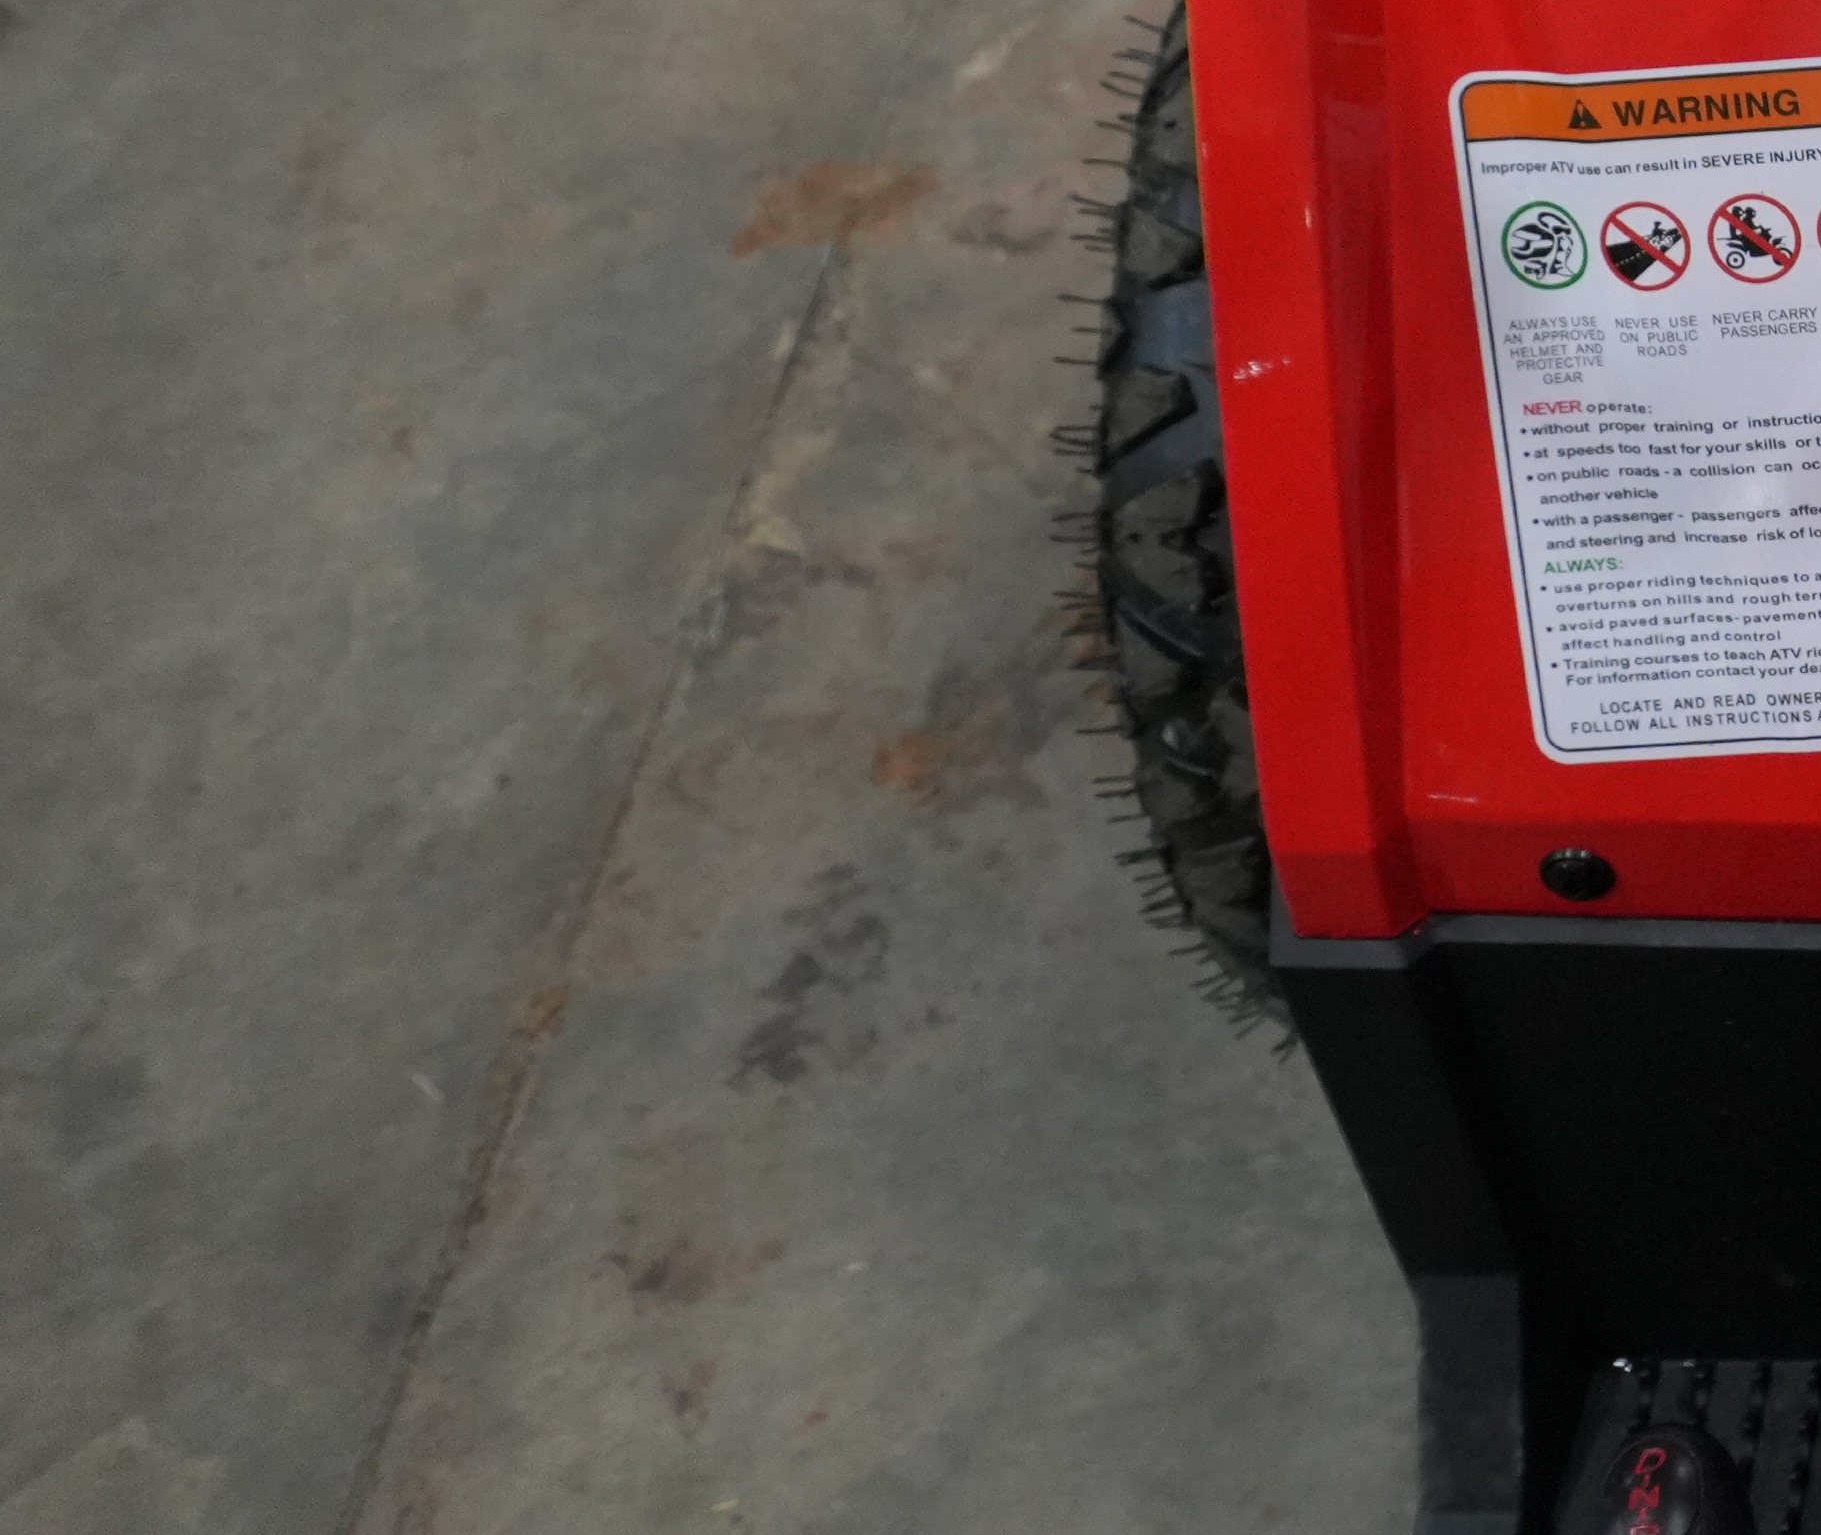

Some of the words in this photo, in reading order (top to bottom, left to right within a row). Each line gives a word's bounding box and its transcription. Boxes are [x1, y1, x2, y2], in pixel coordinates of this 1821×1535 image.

[1612, 88, 1801, 128] WARNING
[1481, 162, 1547, 175] Improper
[1551, 161, 1574, 173] ATV
[1577, 166, 1600, 175] use
[1605, 163, 1631, 174] can
[1636, 158, 1680, 173] result
[1701, 152, 1766, 168] SEVERE
[1509, 317, 1567, 331] ALWAYS
[1571, 316, 1597, 327] USE
[1615, 317, 1660, 329] NEVER
[1669, 315, 1698, 327] USE
[1712, 310, 1763, 325] NEVER
[1768, 307, 1818, 321] CARRY
[1532, 330, 1605, 343] APPROVED
[1619, 332, 1639, 343] ON
[1647, 330, 1698, 343] PUBLIC
[1720, 321, 1818, 338] PASSENGERS
[1509, 344, 1567, 358] HELMET
[1576, 343, 1603, 354] AND
[1637, 345, 1687, 357] ROADS
[1516, 356, 1604, 371] PROTECTIVE
[1542, 371, 1583, 385] GEAR
[1523, 400, 1582, 415] NEVER
[1586, 402, 1652, 416] operate:
[1531, 422, 1590, 435] without
[1599, 421, 1645, 433] proper
[1654, 420, 1714, 433] training
[1722, 419, 1739, 430] or
[1533, 447, 1548, 458] at
[1557, 444, 1614, 459] speeds
[1618, 443, 1640, 454] too
[1648, 443, 1677, 455] fast
[1681, 442, 1701, 454] for
[1705, 442, 1741, 457] your
[1745, 437, 1786, 452] skills
[1795, 438, 1812, 448] or
[1537, 471, 1556, 481] on
[1561, 467, 1610, 483] public
[1619, 466, 1660, 477] roads
[1689, 465, 1755, 477] collision
[1764, 462, 1793, 473] can
[1540, 491, 1600, 505] another
[1604, 487, 1659, 500] vehicle
[1542, 515, 1576, 527] with
[1593, 510, 1674, 527] passenger
[1691, 507, 1781, 523] passengers
[1546, 537, 1575, 550] and
[1579, 533, 1644, 548] steering
[1647, 532, 1676, 543] and
[1684, 530, 1748, 543] increase
[1757, 529, 1785, 542] risk
[1789, 527, 1806, 539] of
[1543, 557, 1624, 574] ALWAYS:
[1554, 584, 1582, 594] use
[1588, 580, 1643, 593] proper
[1647, 575, 1695, 588] riding
[1700, 573, 1789, 588] techniques
[1794, 572, 1810, 583] to
[1556, 595, 1637, 613] overturns
[1641, 597, 1662, 607] on
[1666, 594, 1702, 605] hills
[1706, 593, 1734, 604] and
[1742, 593, 1791, 606] rough
[1559, 619, 1604, 632] avoid
[1609, 615, 1658, 631] paved
[1561, 638, 1608, 651] affect
[1614, 634, 1685, 647] handling
[1691, 632, 1720, 643] and
[1725, 631, 1781, 641] control
[1563, 656, 1630, 670] Training
[1634, 652, 1699, 666] courses
[1704, 650, 1720, 661] to
[1724, 649, 1765, 661] teach
[1770, 647, 1802, 661] ATV
[1566, 674, 1592, 686] For
[1598, 668, 1691, 684] information
[1696, 665, 1756, 678] contact
[1759, 665, 1794, 678] your
[1599, 699, 1663, 715] LOCATE
[1674, 696, 1705, 710] AND
[1713, 693, 1756, 707] READ
[1571, 719, 1640, 734] FOLLOW
[1650, 715, 1677, 730] ALL
[1686, 710, 1812, 726] INSTRUCTIONS
